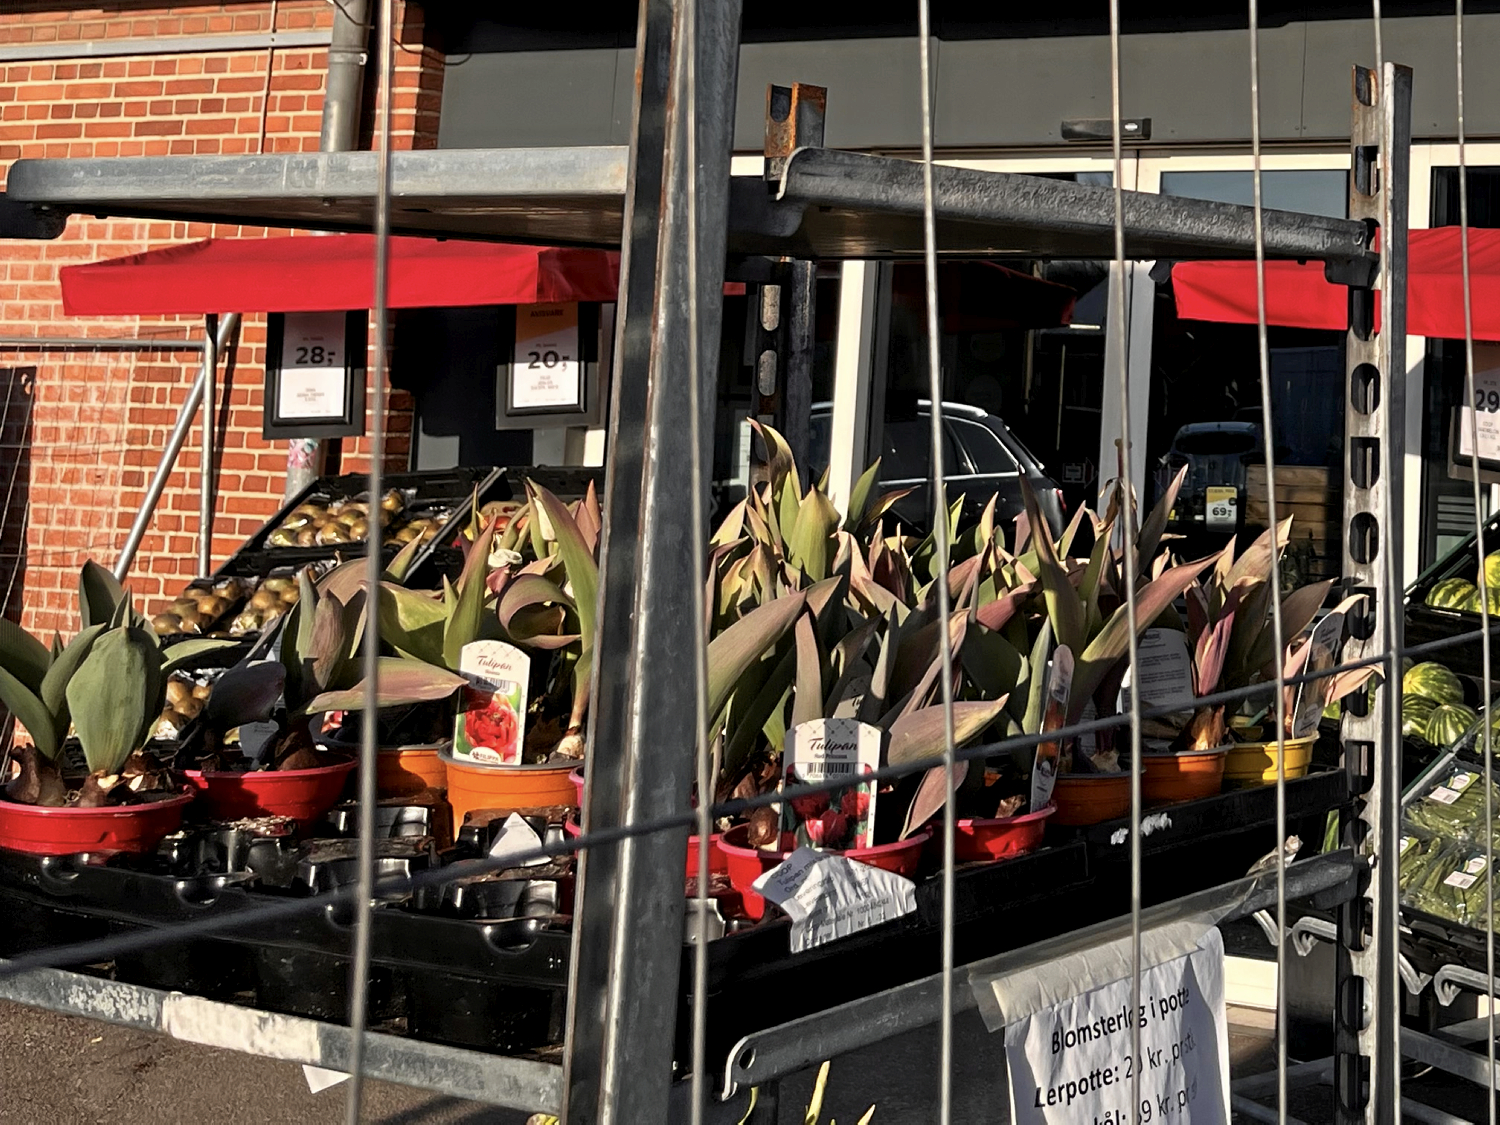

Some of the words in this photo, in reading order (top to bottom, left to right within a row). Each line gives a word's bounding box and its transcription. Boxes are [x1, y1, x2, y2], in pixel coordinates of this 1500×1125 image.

[477, 655, 513, 672] Tulipan
[808, 737, 858, 754] Tulipan
[1149, 996, 1156, 1019] i
[1147, 1046, 1169, 1070] kr.
[1156, 1093, 1175, 1117] kr.
